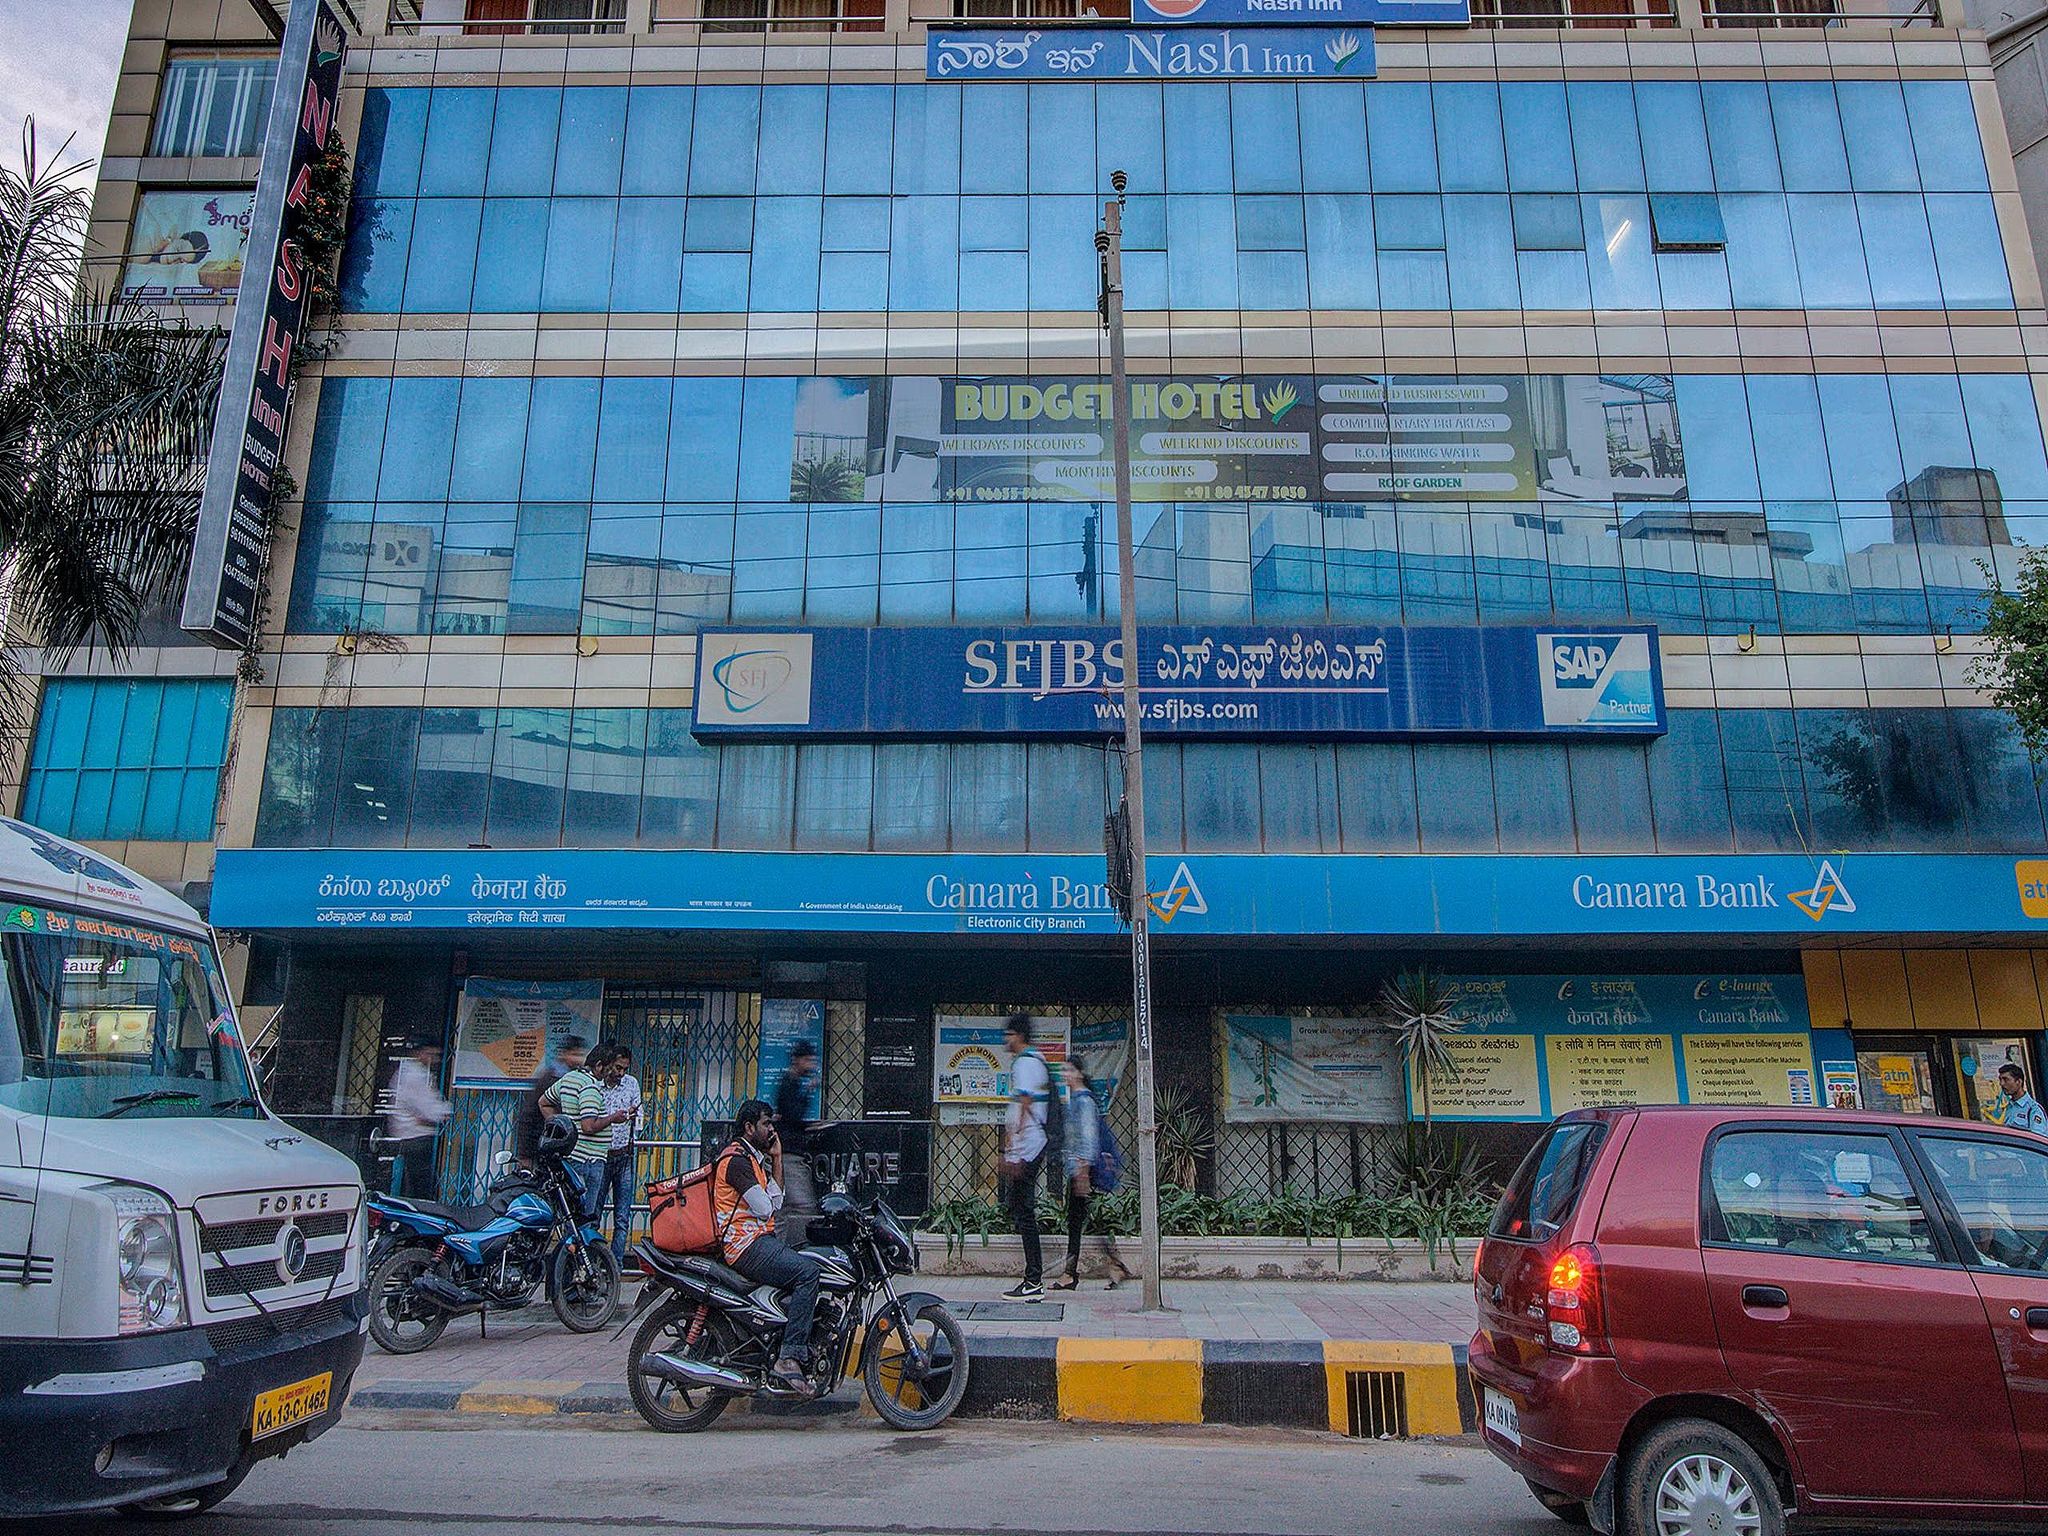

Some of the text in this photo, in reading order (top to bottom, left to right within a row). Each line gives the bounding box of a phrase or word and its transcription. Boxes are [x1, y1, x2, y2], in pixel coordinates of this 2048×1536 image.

[1124, 29, 1315, 75] Nash Inn
[955, 383, 1261, 421] BUDGET HOTEL
[251, 387, 281, 437] Inn
[244, 432, 276, 470] BUDGET
[941, 438, 1086, 450] WEEKDAYS DISCOUNTS
[1159, 437, 1299, 449] WEEKEND DISCOUNTS
[1441, 447, 1481, 458] WATER
[240, 458, 271, 491] HOTEL
[1378, 478, 1462, 488] ROOF GARDEN
[963, 639, 1126, 701] SFJBS
[1553, 646, 1607, 680] SAP
[738, 670, 767, 691] SFJ
[1609, 699, 1652, 714] Partner
[471, 872, 568, 900] केनरा बैंक
[1049, 875, 1119, 909] Ban
[1572, 874, 1779, 909] Canara Bank
[2023, 879, 2048, 899] at
[850, 902, 865, 910] India
[866, 903, 903, 912] Undertaking
[967, 916, 1086, 931] Electronic City Branch
[1718, 978, 1773, 994] e-lounge
[1698, 1007, 1782, 1024] Canara Bank
[1299, 1026, 1318, 1035] Grow
[1689, 1040, 1700, 1048] The
[1704, 1040, 1720, 1050] lobby
[1721, 1040, 1731, 1048] will
[1731, 1040, 1745, 1048] have
[1745, 1040, 1756, 1048] the
[1755, 1040, 1782, 1050] following
[1782, 1040, 1804, 1048] services
[949, 1046, 975, 1068] DIGITAL
[976, 1046, 1000, 1069] MONTH
[1718, 1057, 1739, 1065] through
[1714, 1068, 1734, 1076] deposit
[1884, 1068, 1910, 1082] atm
[1702, 1079, 1722, 1087] Cheque
[1722, 1079, 1741, 1087] deposit
[1727, 1090, 1748, 1098] printing
[258, 1192, 330, 1216] FORCE
